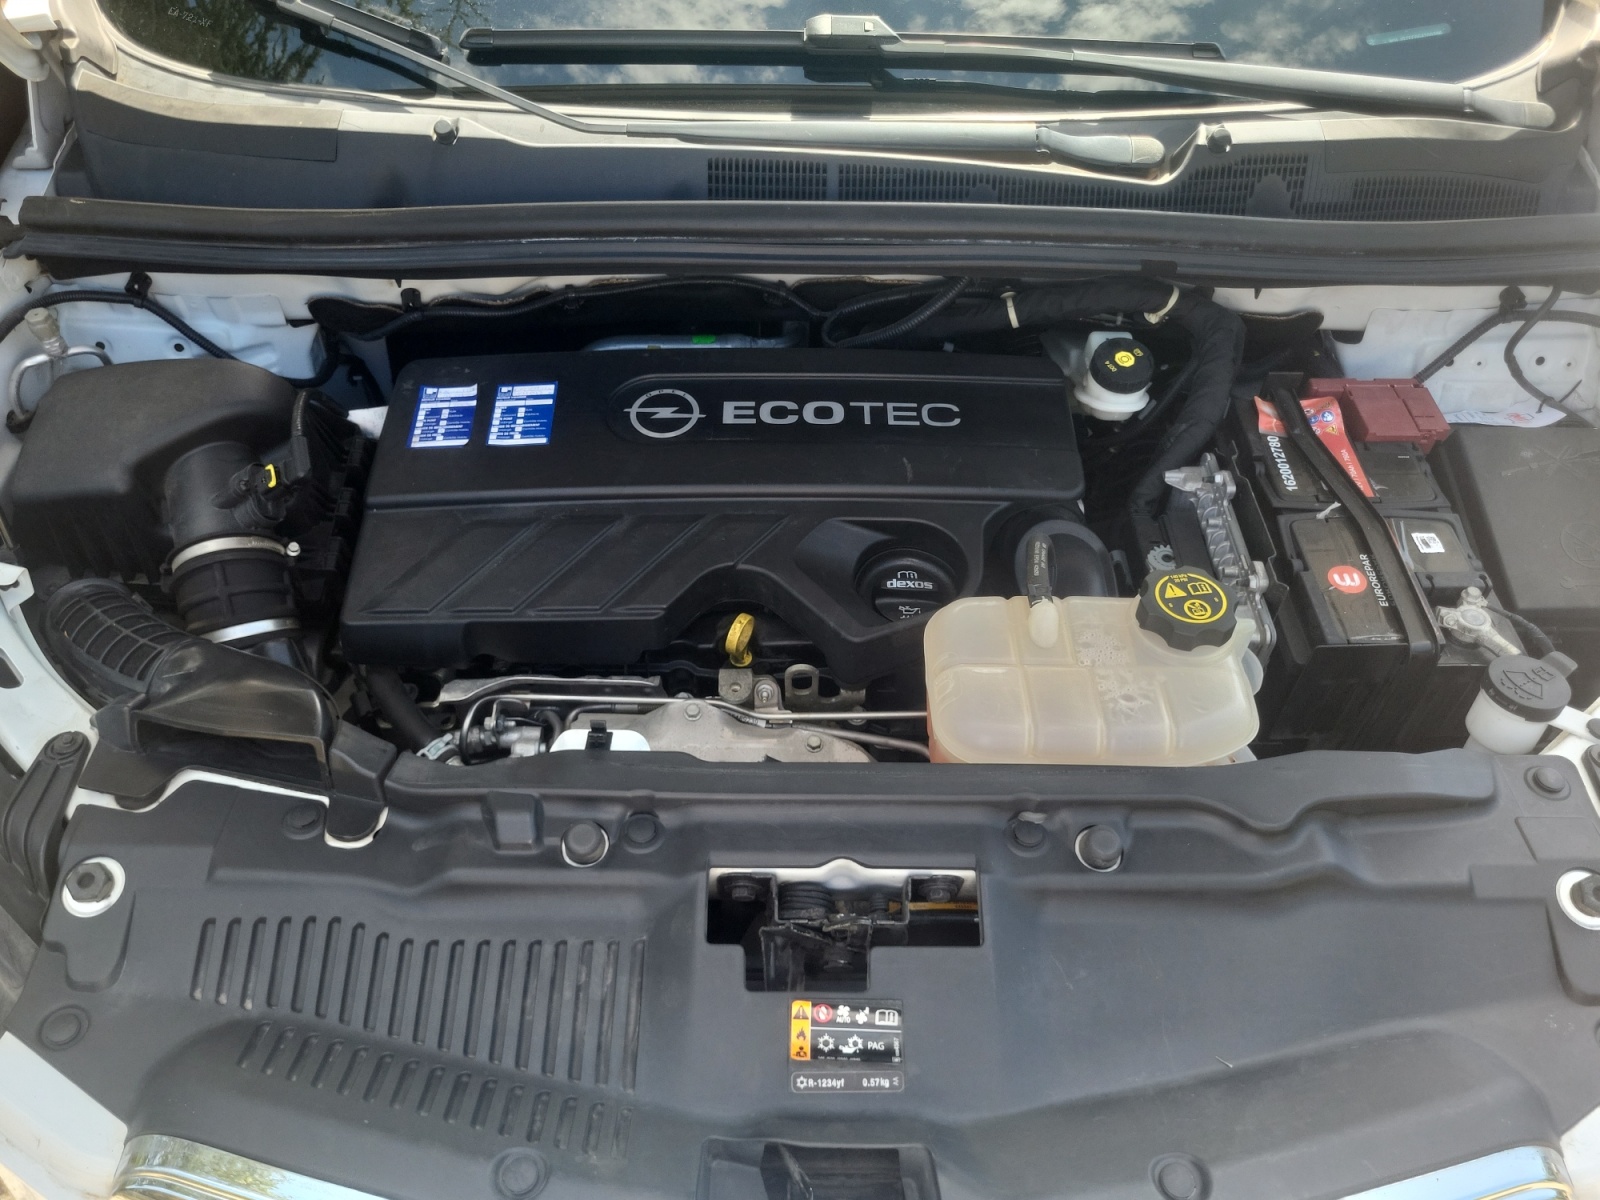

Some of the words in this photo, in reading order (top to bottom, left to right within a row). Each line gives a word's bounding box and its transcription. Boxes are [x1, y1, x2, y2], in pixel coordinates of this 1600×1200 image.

[722, 401, 961, 427] ECOTEC
[1267, 435, 1298, 491] 1620012780
[886, 579, 934, 590] dexos
[1359, 554, 1389, 607] EUROREPAR
[867, 1041, 885, 1051] PAG
[808, 1078, 845, 1089] R-1234yf
